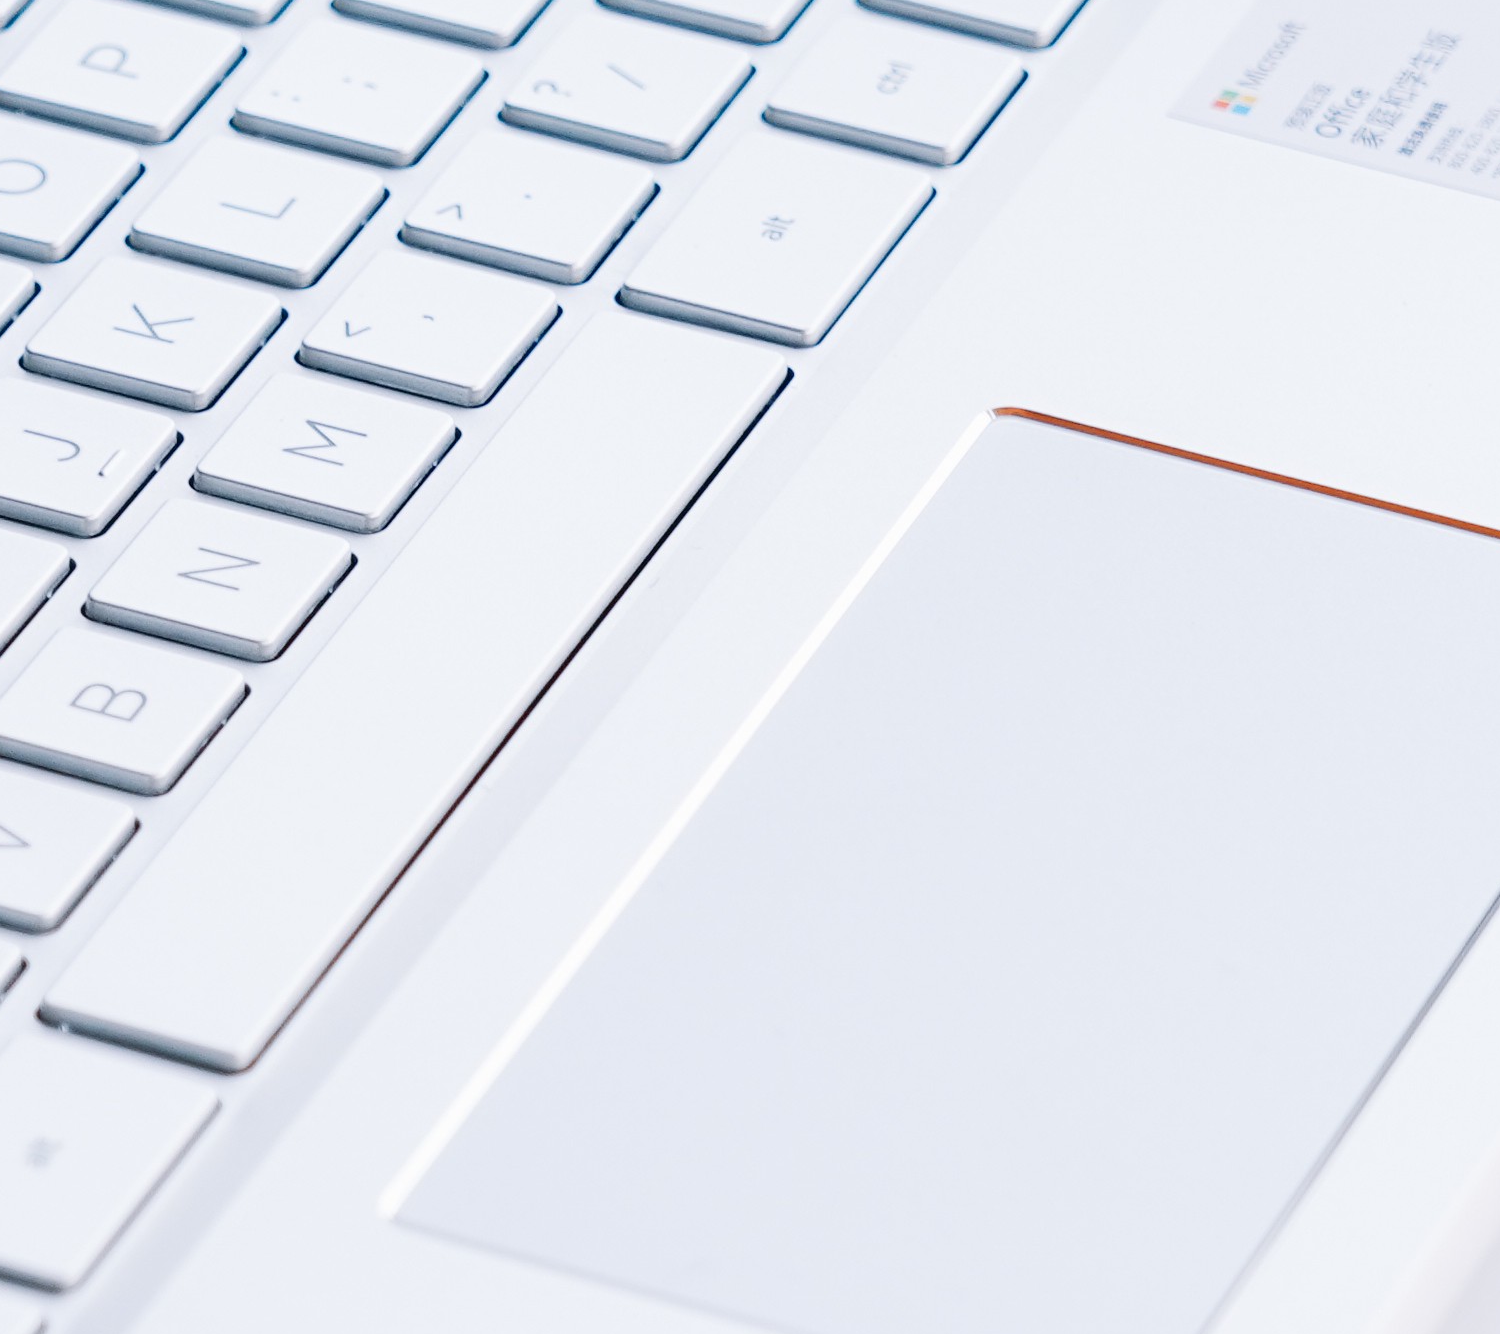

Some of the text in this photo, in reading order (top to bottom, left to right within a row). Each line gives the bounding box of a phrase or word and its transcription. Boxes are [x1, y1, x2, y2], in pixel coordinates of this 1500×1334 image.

[79, 43, 139, 80] P
[1237, 20, 1306, 90] Microsoft
[875, 59, 916, 97] ctrl
[1315, 87, 1371, 139] Office
[219, 196, 298, 222] L
[760, 211, 797, 243] alt
[112, 303, 195, 345] K
[22, 427, 82, 464] J
[281, 418, 369, 467] M
[176, 544, 262, 591] N
[70, 683, 149, 723] B
